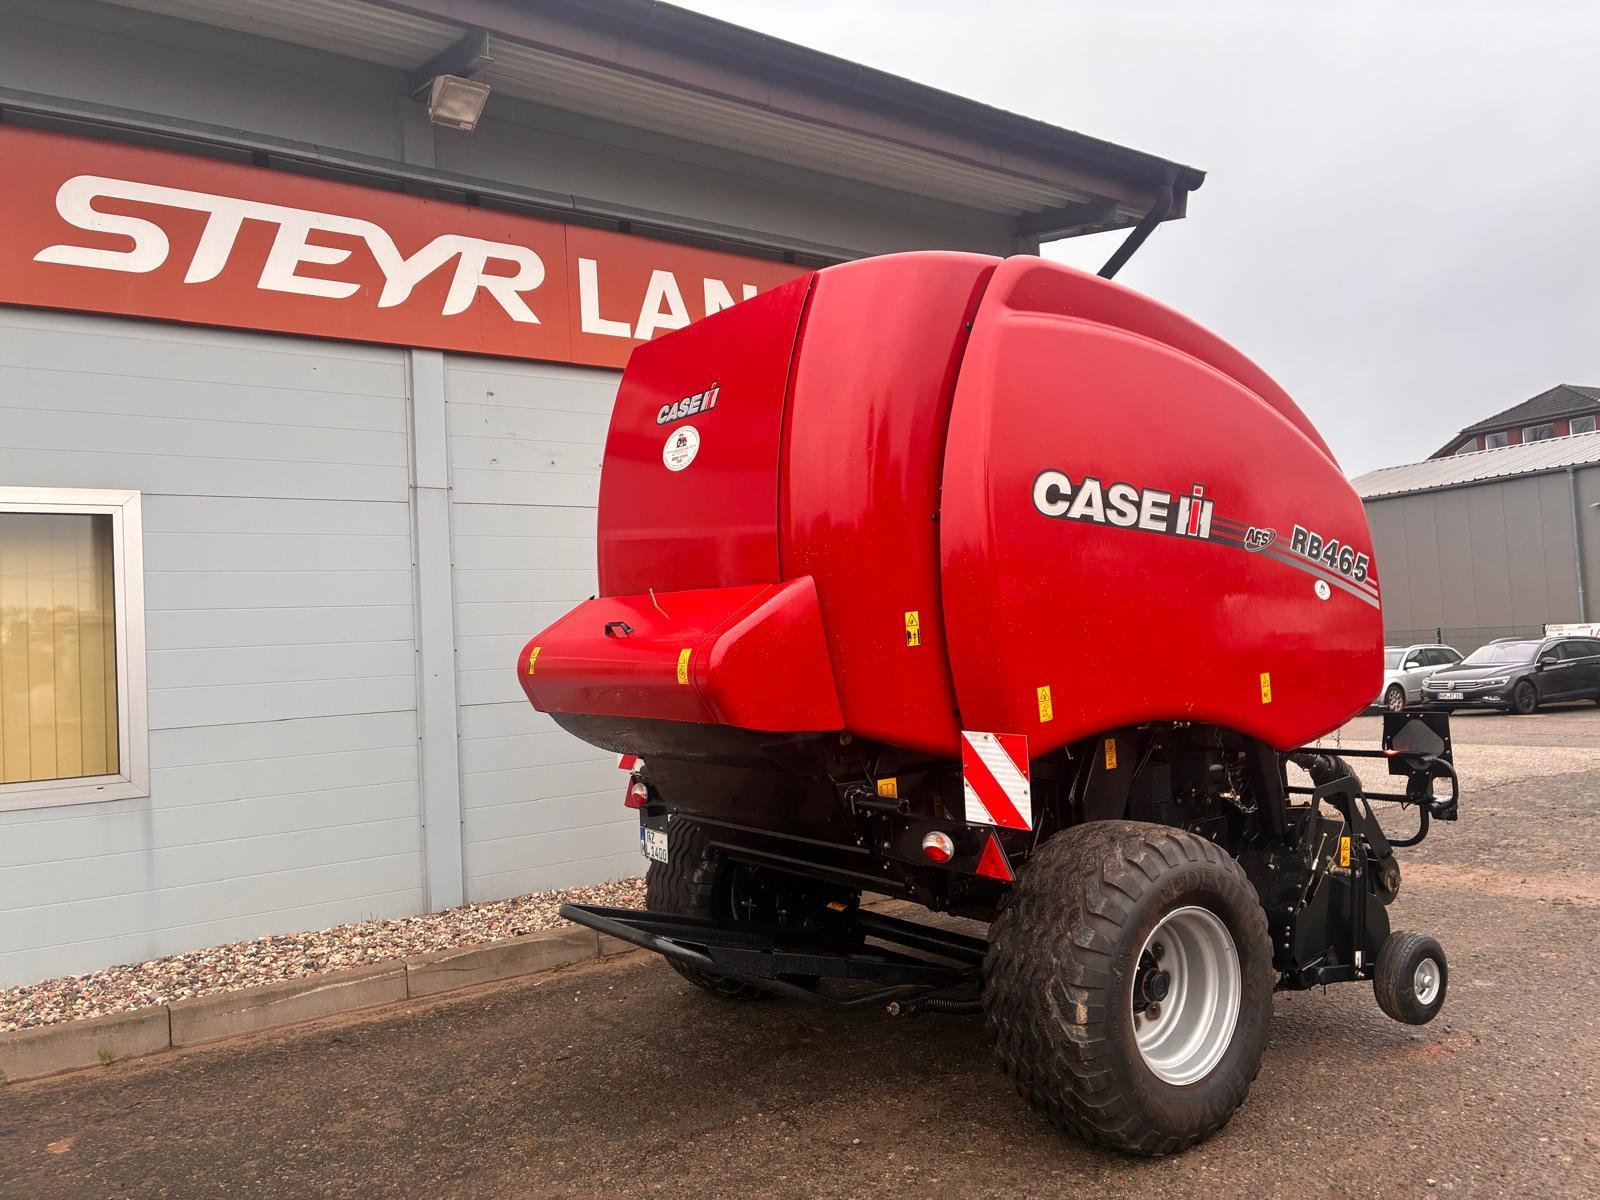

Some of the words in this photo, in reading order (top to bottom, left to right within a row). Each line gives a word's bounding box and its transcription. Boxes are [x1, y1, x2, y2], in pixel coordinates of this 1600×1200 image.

[33, 174, 546, 325] STEYR
[657, 393, 702, 425] CASE
[1033, 470, 1171, 533] CASE
[1244, 526, 1270, 547] AFS
[1290, 523, 1370, 584] RB465
